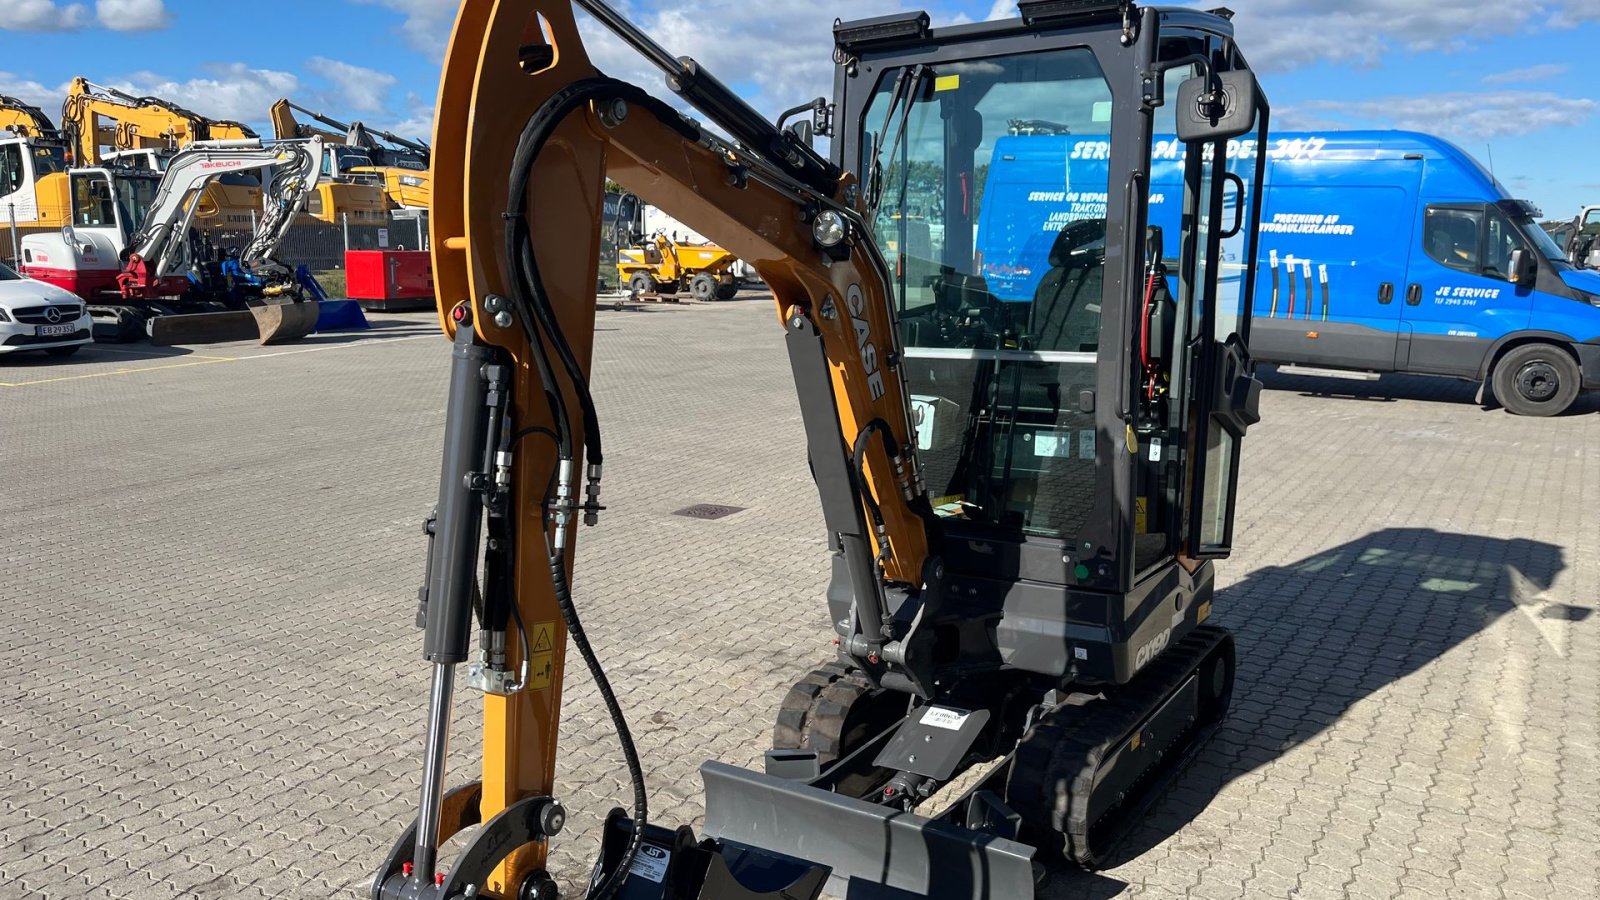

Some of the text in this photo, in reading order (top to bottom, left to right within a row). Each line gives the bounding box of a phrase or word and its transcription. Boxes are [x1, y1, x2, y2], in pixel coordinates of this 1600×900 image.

[1028, 192, 1064, 201] SERVICE
[1066, 193, 1078, 202] OG
[1273, 213, 1339, 224] PRESNING AF
[1435, 286, 1500, 299] JE SERVICE
[42, 326, 52, 334] EB
[54, 325, 61, 333] 29
[847, 283, 886, 401] CASE
[1135, 628, 1171, 670] CX19D
